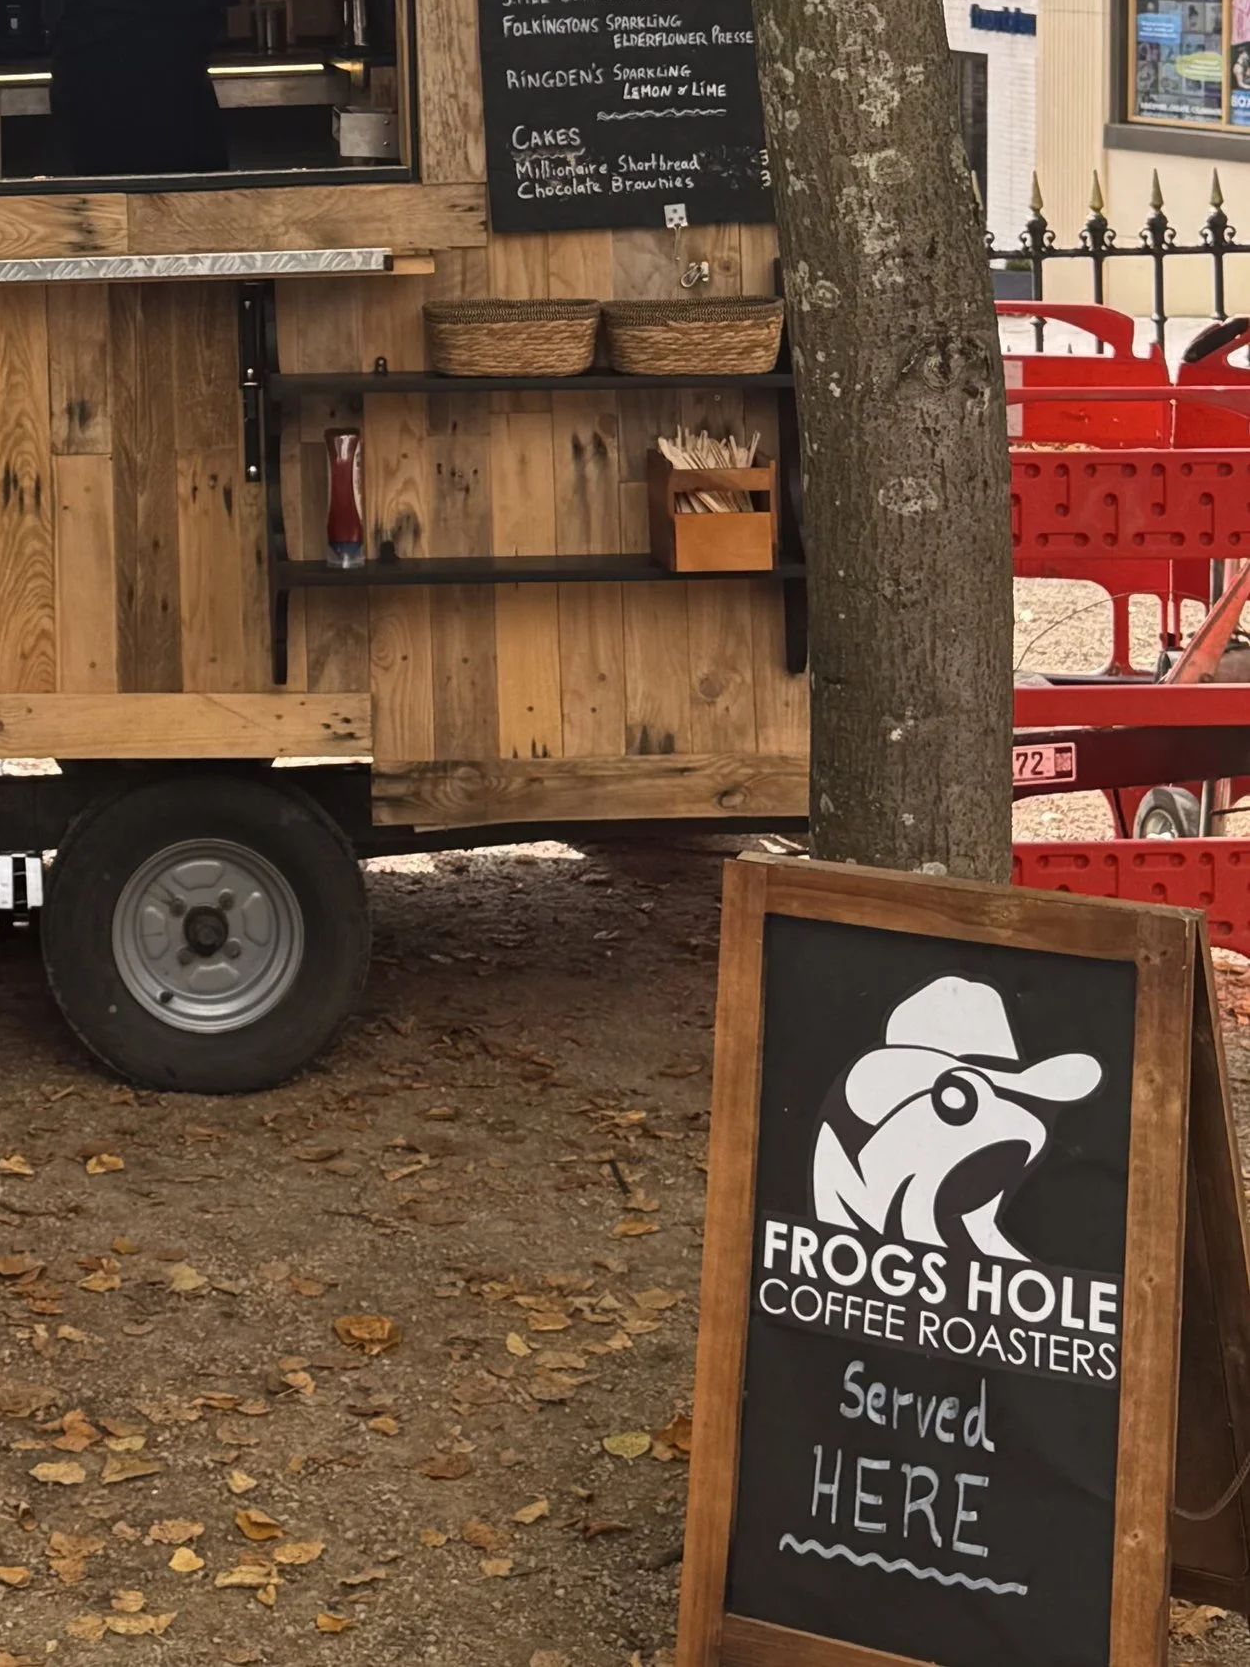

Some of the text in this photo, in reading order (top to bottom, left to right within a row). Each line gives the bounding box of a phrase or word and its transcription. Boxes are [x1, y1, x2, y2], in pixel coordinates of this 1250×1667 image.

[613, 32, 709, 49] ELDERFLOWER
[623, 82, 672, 100] LEMON
[512, 125, 581, 149] CAKES
[515, 160, 608, 180] Millionaire
[618, 153, 700, 173] Shortbread
[517, 178, 602, 199] Chocolate
[611, 176, 695, 193] Brownies
[763, 1220, 1118, 1335] FROGS HOLE
[759, 1277, 1117, 1380] COFFEE ROASTERS
[839, 1360, 996, 1452] Served
[811, 1444, 990, 1558] HERE
